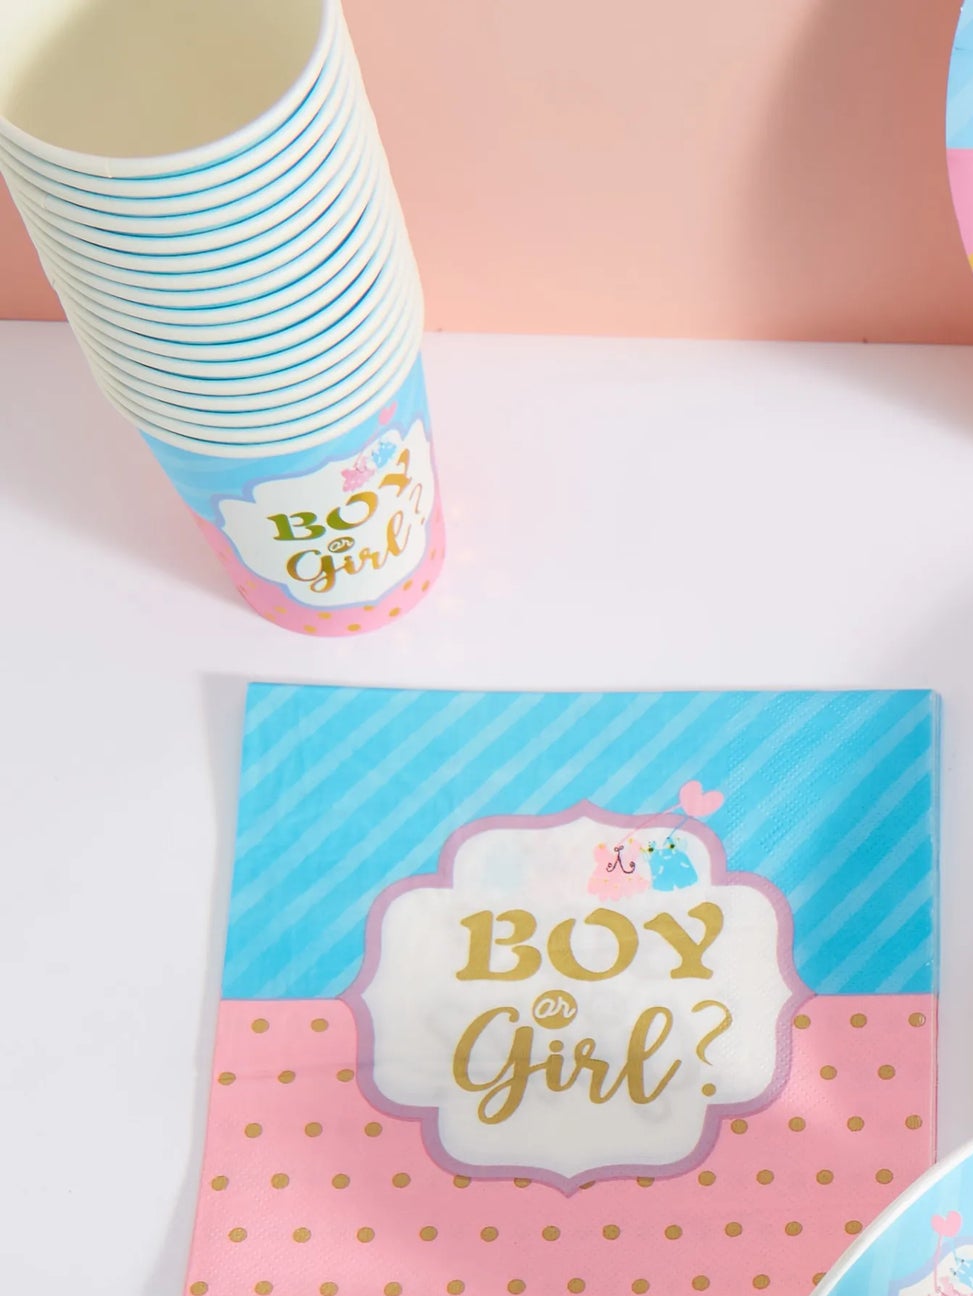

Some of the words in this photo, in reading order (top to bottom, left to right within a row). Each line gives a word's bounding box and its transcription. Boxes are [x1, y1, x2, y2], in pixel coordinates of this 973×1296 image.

[266, 448, 412, 541] BOY
[286, 483, 425, 593] Girl?
[455, 901, 724, 981] BOY
[533, 996, 576, 1018] or
[452, 999, 733, 1125] Girl?
